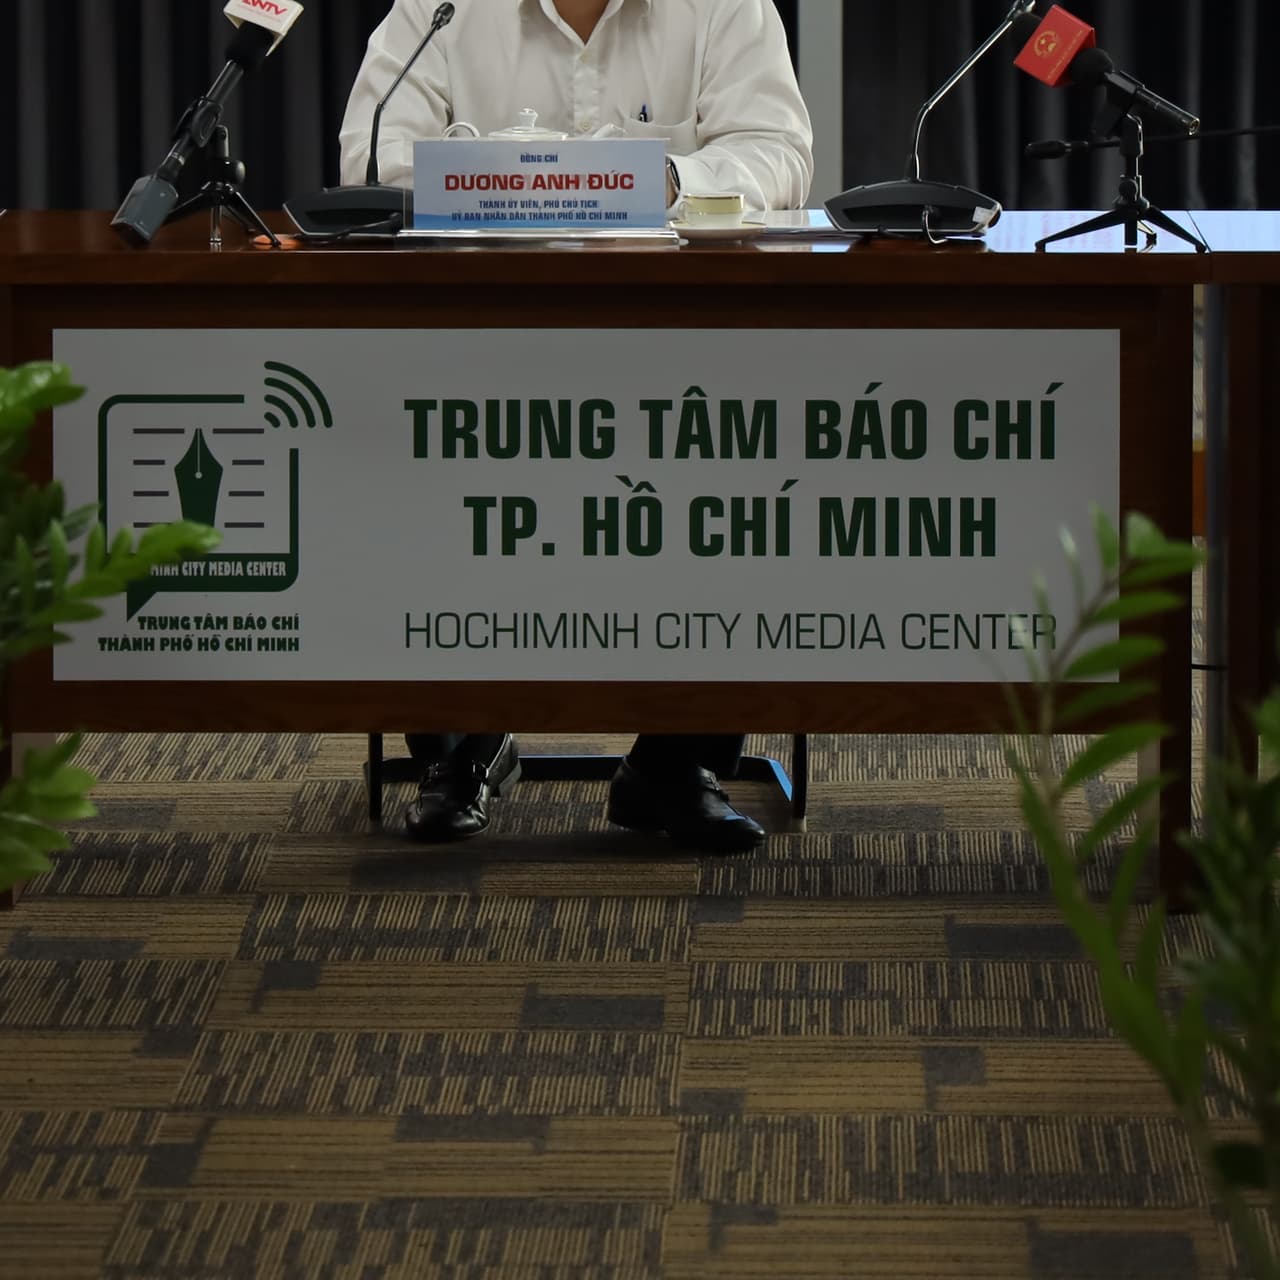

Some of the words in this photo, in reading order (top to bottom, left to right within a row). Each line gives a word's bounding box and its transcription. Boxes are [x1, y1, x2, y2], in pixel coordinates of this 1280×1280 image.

[445, 173, 524, 191] DƯƠNG
[532, 174, 580, 191] ANH
[587, 169, 634, 191] ĐỨC
[404, 397, 616, 460] TRUNG
[639, 385, 778, 460] TÂM
[805, 381, 928, 460] BÁO
[953, 381, 1065, 461] CHÍ
[463, 496, 556, 557] TP.
[583, 475, 663, 558] HỒ
[689, 479, 800, 558] CHÍ
[818, 496, 997, 558] MINH
[182, 561, 206, 577] CITY
[208, 561, 244, 577] MEDIA
[246, 561, 287, 577] CENTER
[137, 616, 191, 631] TRUNG
[193, 613, 229, 631] TÂM
[232, 613, 267, 631] BÁO
[271, 613, 300, 631] CHÍ
[404, 611, 639, 650] HOCHIMINH
[655, 612, 743, 650] CITY
[756, 612, 887, 650] MEDIA
[901, 612, 1057, 650] CENTER
[97, 633, 156, 652] THÀNH
[159, 633, 195, 652] PHỐ
[197, 634, 221, 652] HỒ
[224, 634, 253, 652] CHÍ
[256, 637, 300, 652] MINH
